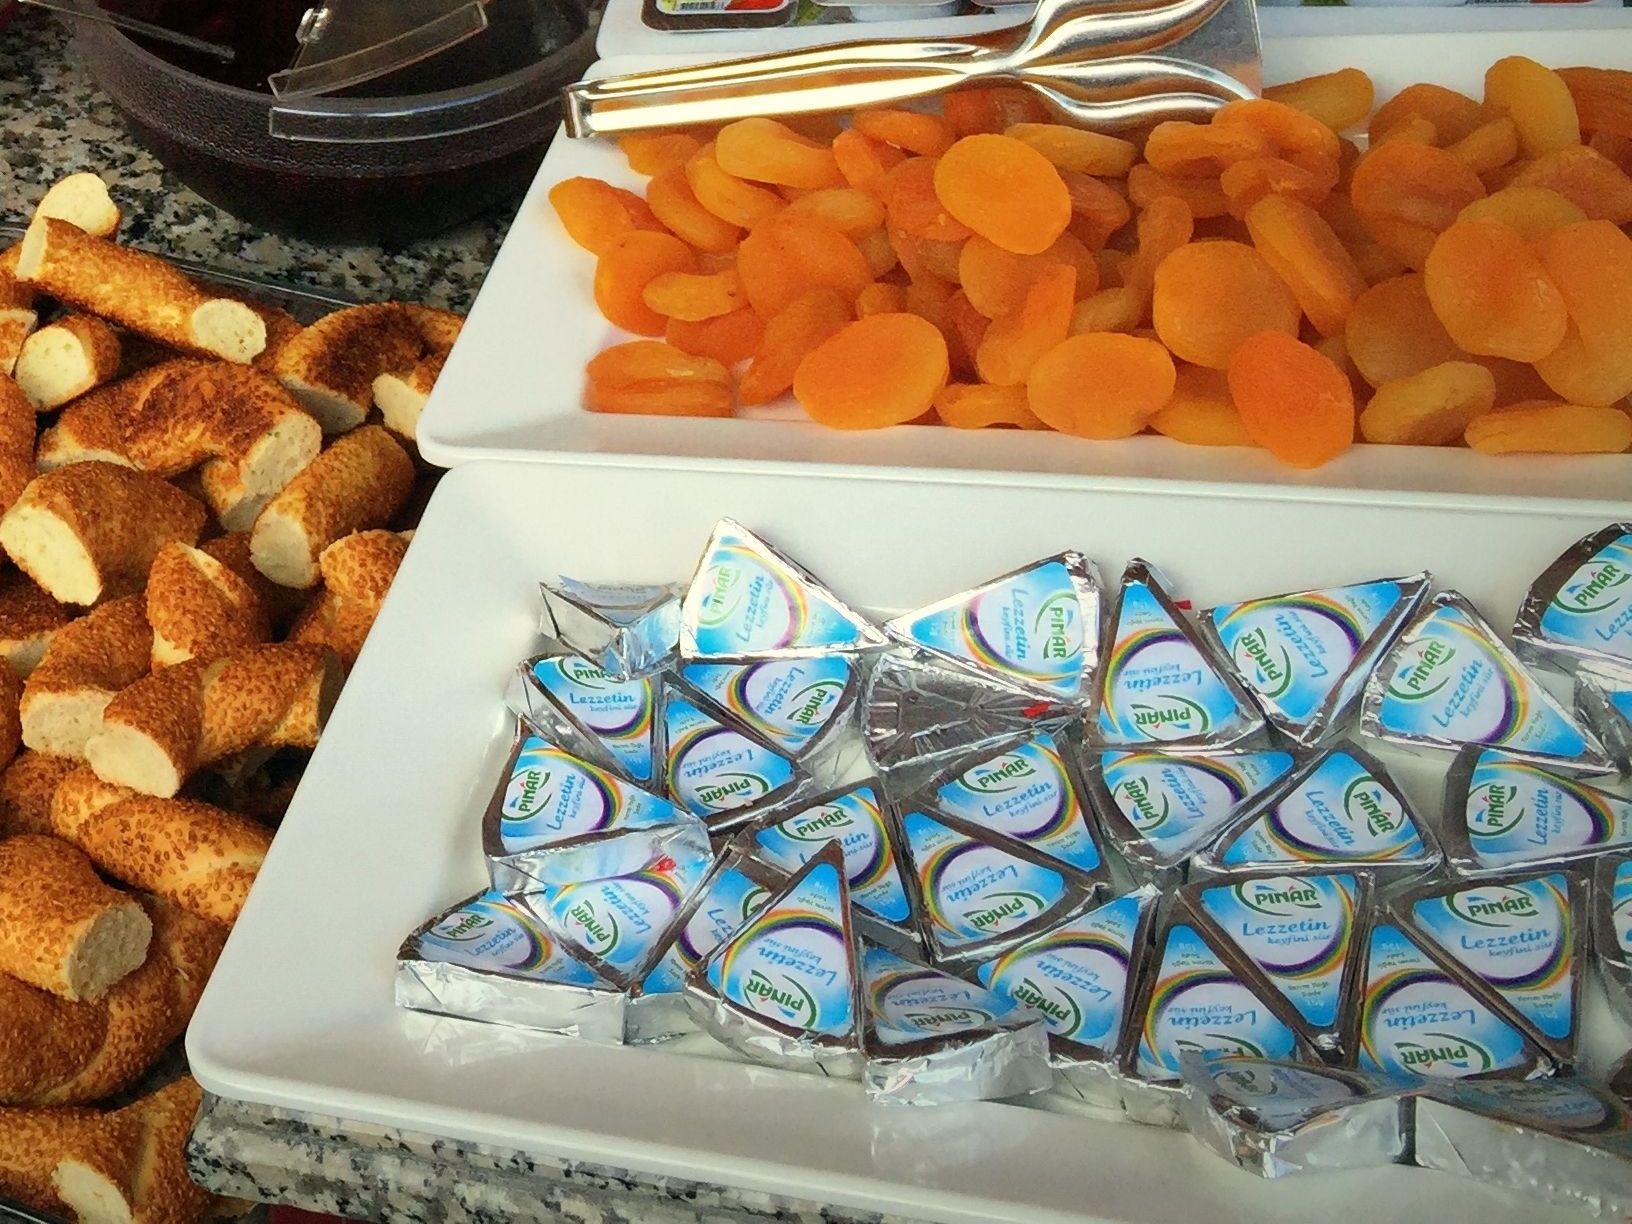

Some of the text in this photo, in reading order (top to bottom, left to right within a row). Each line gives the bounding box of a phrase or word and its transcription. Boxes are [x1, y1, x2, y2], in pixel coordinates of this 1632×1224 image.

[710, 567, 733, 617] PINAR
[1574, 564, 1621, 607] PINAR
[735, 575, 765, 642] Lezzetin
[1011, 588, 1029, 660] Lezzetin
[1049, 607, 1066, 659] PINAR
[1275, 615, 1329, 678] Lezzetin
[1241, 632, 1280, 682] PINAR
[1406, 639, 1446, 692] PINAR
[570, 692, 634, 704] Lezzetin
[765, 666, 805, 715] Lezzetin
[1124, 668, 1203, 691] Lezzetin
[1431, 658, 1484, 729] Lezzetin
[795, 689, 830, 726] PINAR
[1135, 706, 1191, 725] PINAR
[684, 749, 754, 778] Lezzetin
[977, 757, 1029, 788] PINAR
[518, 770, 541, 812] PINAR
[547, 773, 576, 831] Lezzetin
[700, 779, 751, 804] PINAR
[982, 781, 1053, 817] Lezzetin
[1123, 780, 1159, 822] PINAR
[1162, 767, 1205, 821] Lezzetin
[1487, 783, 1506, 827] PINAR
[796, 810, 848, 837] PINAR
[1305, 790, 1356, 847] Lezzetin
[1353, 791, 1396, 834] PINAR
[1527, 788, 1548, 846] Lezzetin
[947, 864, 1018, 903] Lezzetin
[1256, 889, 1318, 906] PINAR
[446, 913, 485, 939] PINAR
[571, 904, 611, 943] PINAR
[600, 886, 652, 934] Lezzetin
[971, 897, 1024, 928] PINAR
[1468, 896, 1533, 917] PINAR
[1242, 919, 1330, 937] Lezzetin
[1461, 928, 1551, 949] Lezzetin
[758, 945, 837, 986] Lezzetin
[1037, 960, 1112, 1002] Lezzetin
[745, 978, 804, 1010] PINAR
[891, 991, 971, 1006] Lezzetin
[1015, 984, 1071, 1021] PINAR
[912, 1011, 970, 1025] PINAR
[1169, 1010, 1257, 1030] Lezzetin
[1384, 1008, 1476, 1031] Lezzetin
[1403, 1046, 1468, 1064] PINAR
